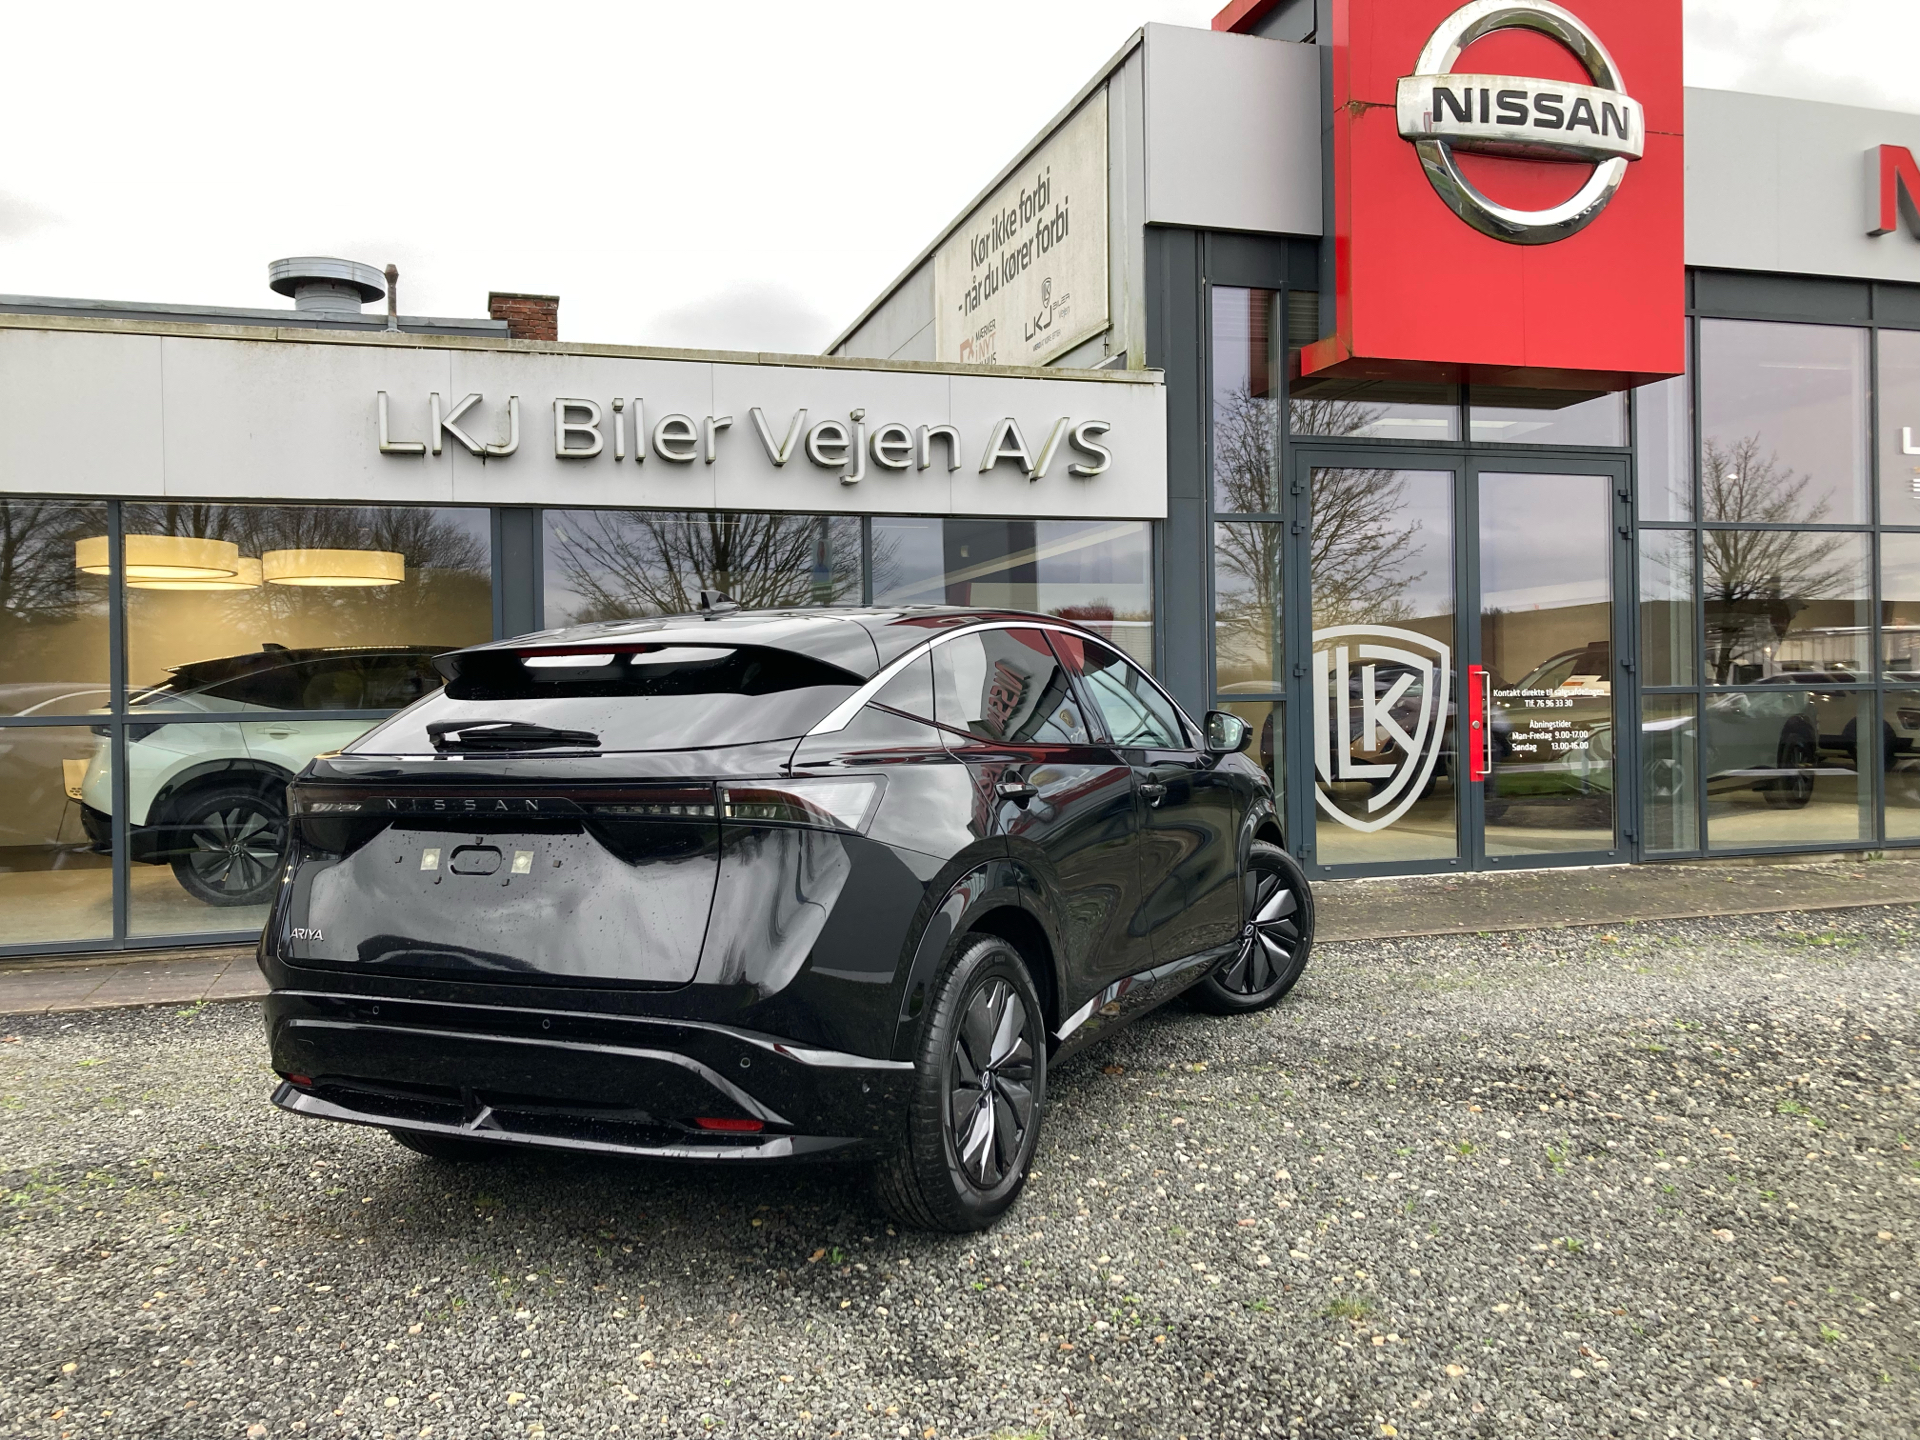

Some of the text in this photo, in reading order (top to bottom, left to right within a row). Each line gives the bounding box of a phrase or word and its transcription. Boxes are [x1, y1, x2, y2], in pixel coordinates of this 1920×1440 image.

[1432, 86, 1630, 141] NISSAN
[970, 165, 1050, 272] Kør ikke forbi
[964, 274, 983, 317] når
[984, 262, 999, 301] du
[1001, 235, 1034, 288] kører
[1035, 194, 1069, 259] forbi
[1024, 304, 1052, 343] LKJ
[979, 331, 996, 361] NYT
[377, 390, 1112, 485] LKJ Biler Vejen A/S
[1493, 687, 1605, 698] Kontakt direkte til salgsafdelingen
[1536, 699, 1544, 707] 76
[1545, 699, 1554, 707] 96
[1555, 699, 1564, 707] 33
[1564, 699, 1573, 707] 30
[1529, 719, 1572, 730] Åbningstider
[1511, 730, 1589, 741] Man-Fredag 9.00-17.00
[1511, 741, 1589, 753] Søndag 13.00-16.00
[386, 798, 540, 811] NISSAN
[289, 927, 324, 942] ARIYA
